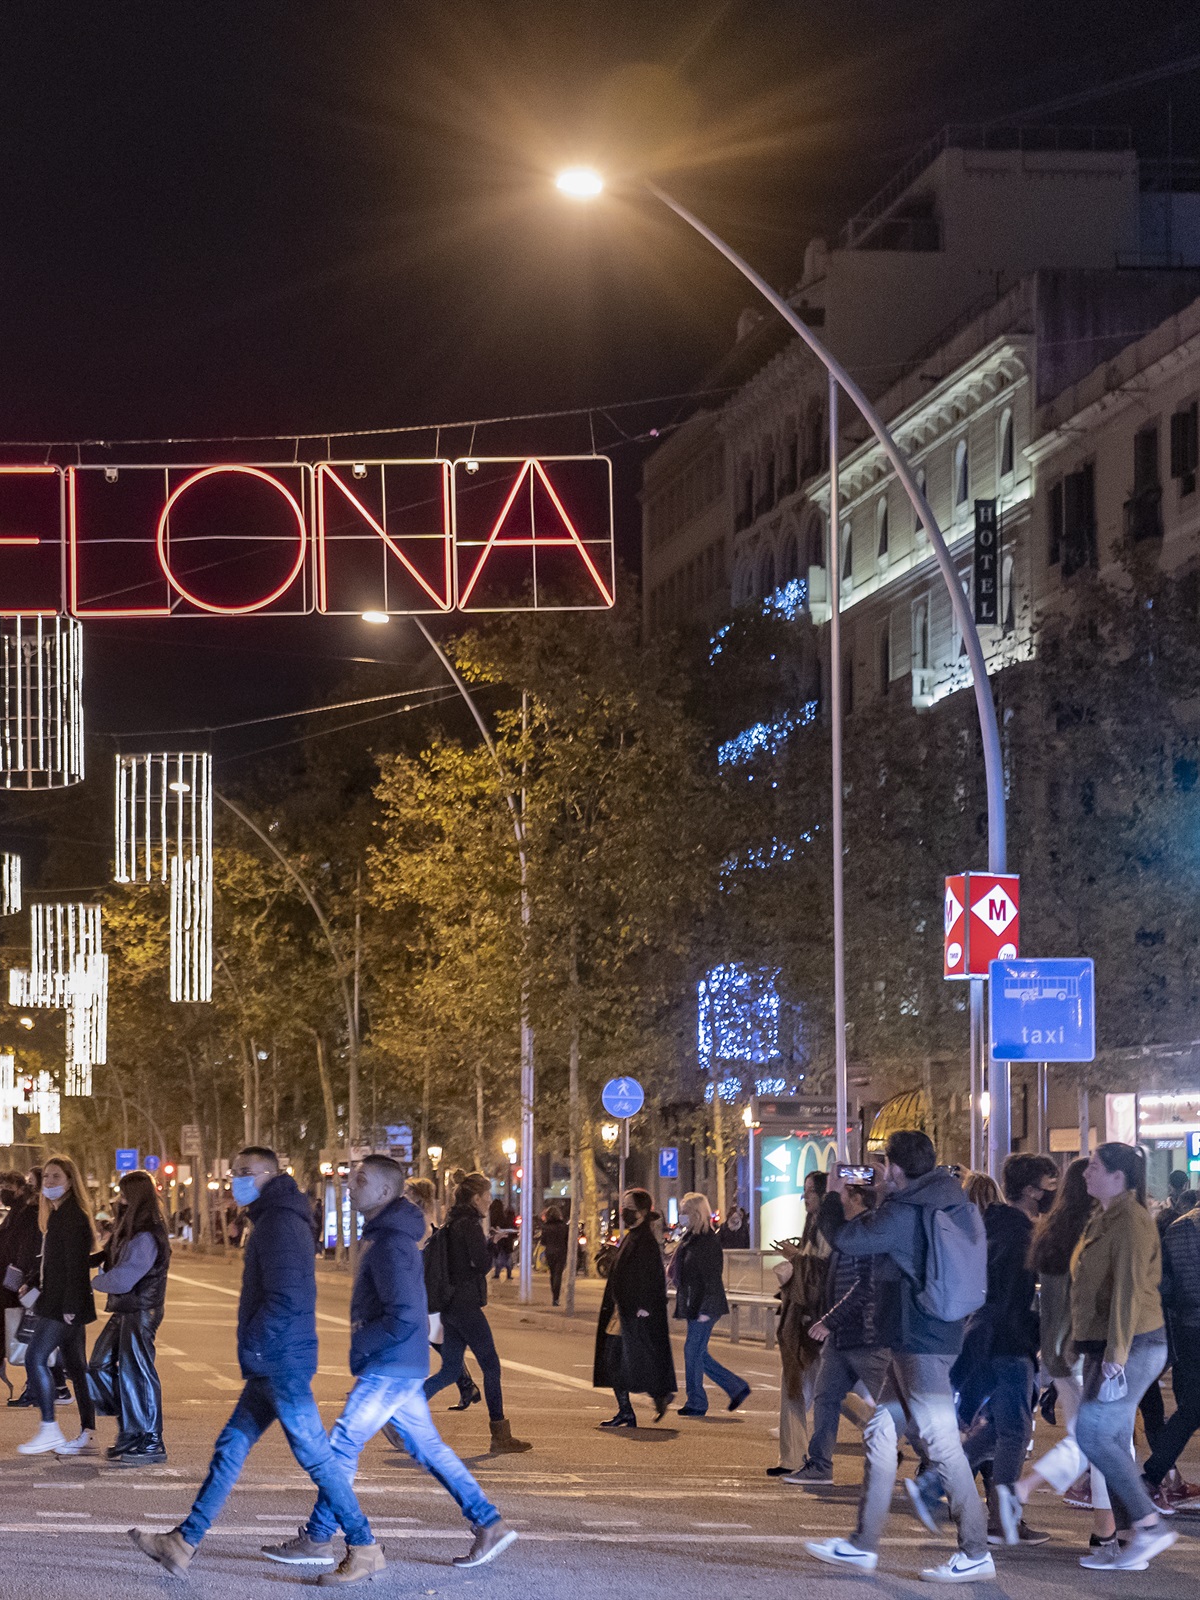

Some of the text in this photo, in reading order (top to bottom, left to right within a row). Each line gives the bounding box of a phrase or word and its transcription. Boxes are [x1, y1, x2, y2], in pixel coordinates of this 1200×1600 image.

[979, 506, 995, 618] HOTEL
[989, 899, 1006, 921] M
[1021, 1026, 1065, 1044] taxi
[663, 1151, 674, 1165] P
